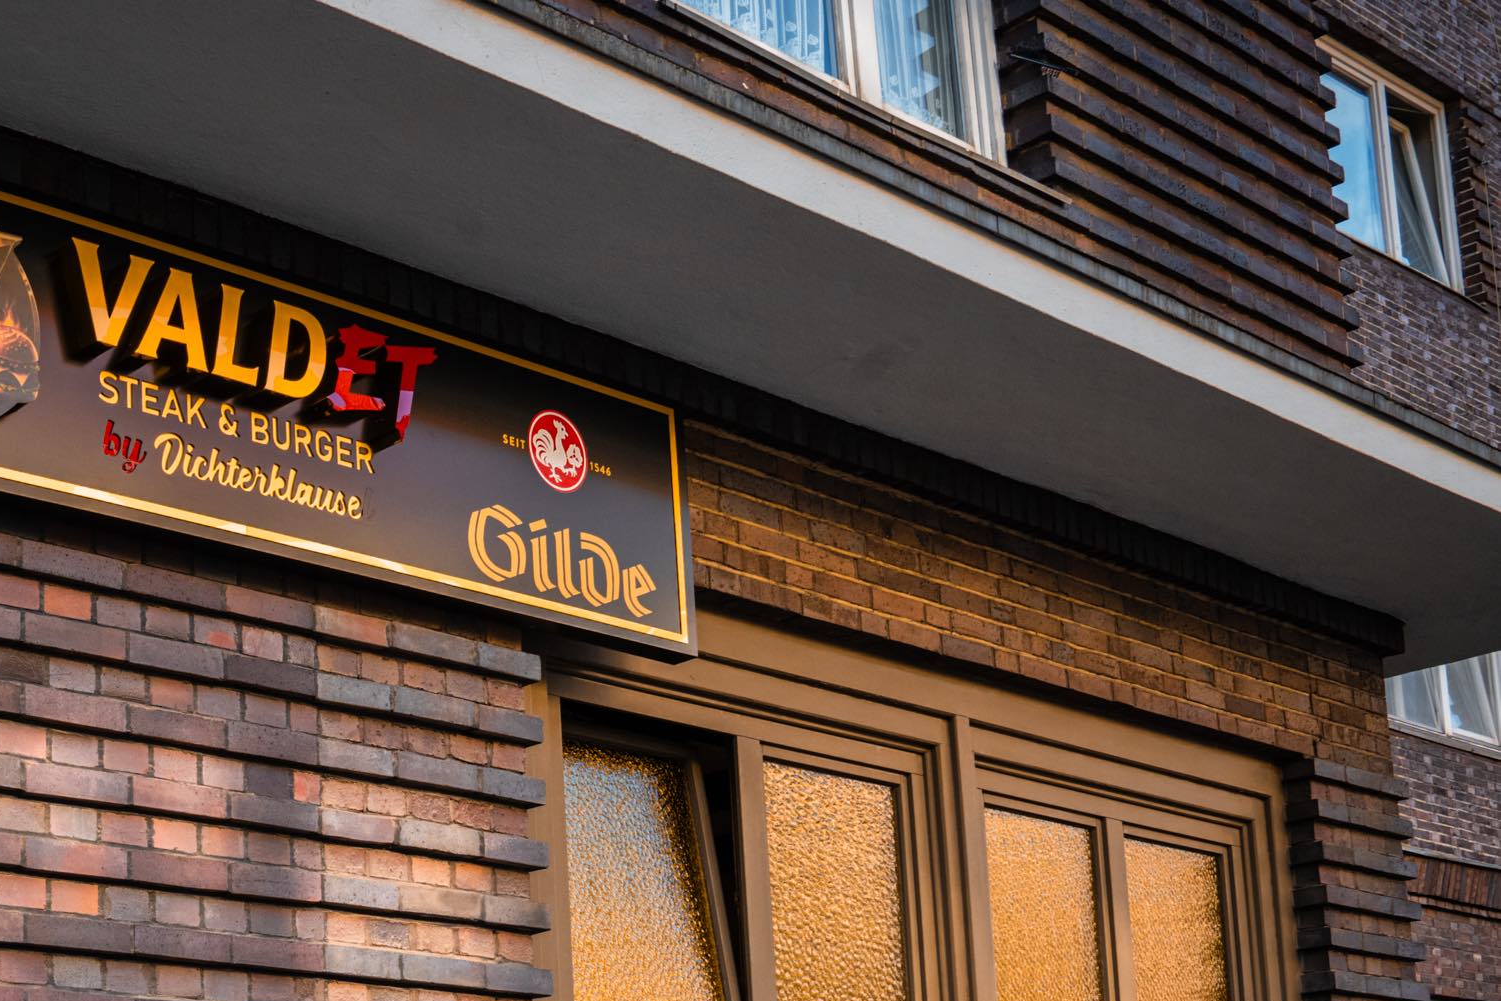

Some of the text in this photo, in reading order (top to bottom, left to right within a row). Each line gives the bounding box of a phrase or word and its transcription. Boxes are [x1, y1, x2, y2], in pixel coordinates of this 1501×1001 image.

[72, 236, 438, 444] VALDET
[98, 370, 376, 474] STEAK & BURGER
[102, 419, 364, 520] by Dichterklause
[502, 433, 612, 477] SEIT 1546
[467, 504, 657, 618] Gilde
